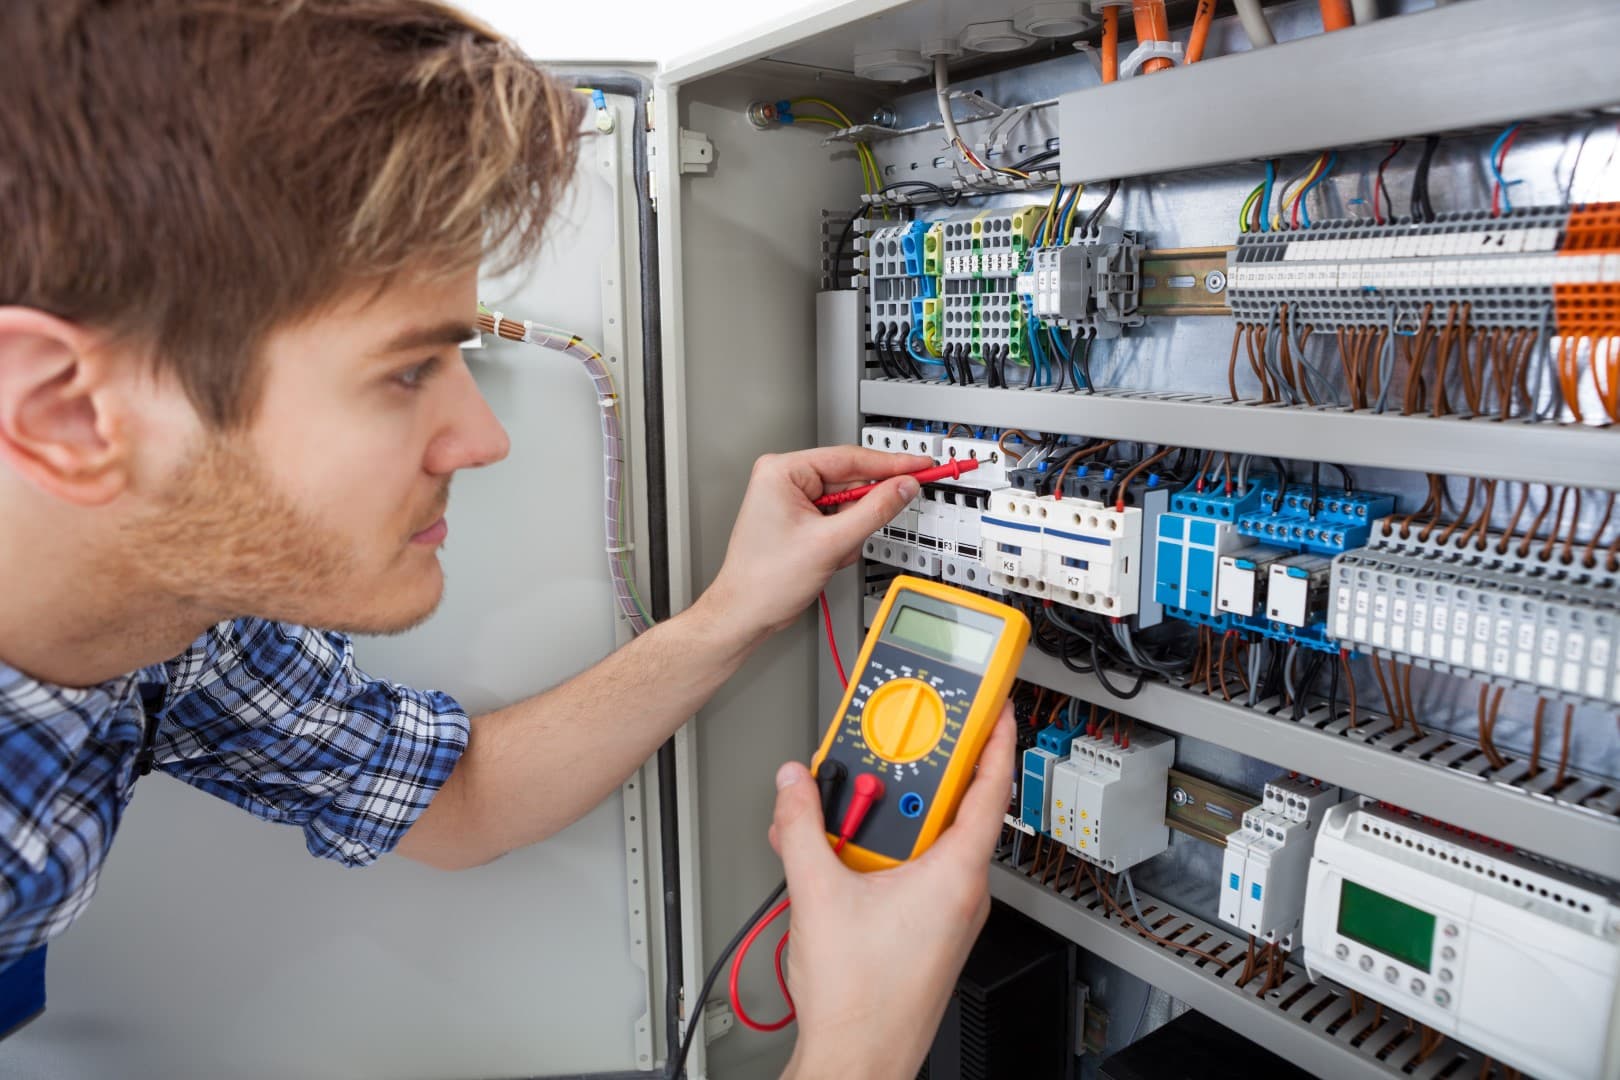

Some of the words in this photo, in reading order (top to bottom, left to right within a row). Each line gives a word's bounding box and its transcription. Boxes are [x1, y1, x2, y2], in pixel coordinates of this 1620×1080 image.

[943, 541, 953, 551] F3
[1003, 560, 1015, 572] K5
[1067, 576, 1080, 586] K7
